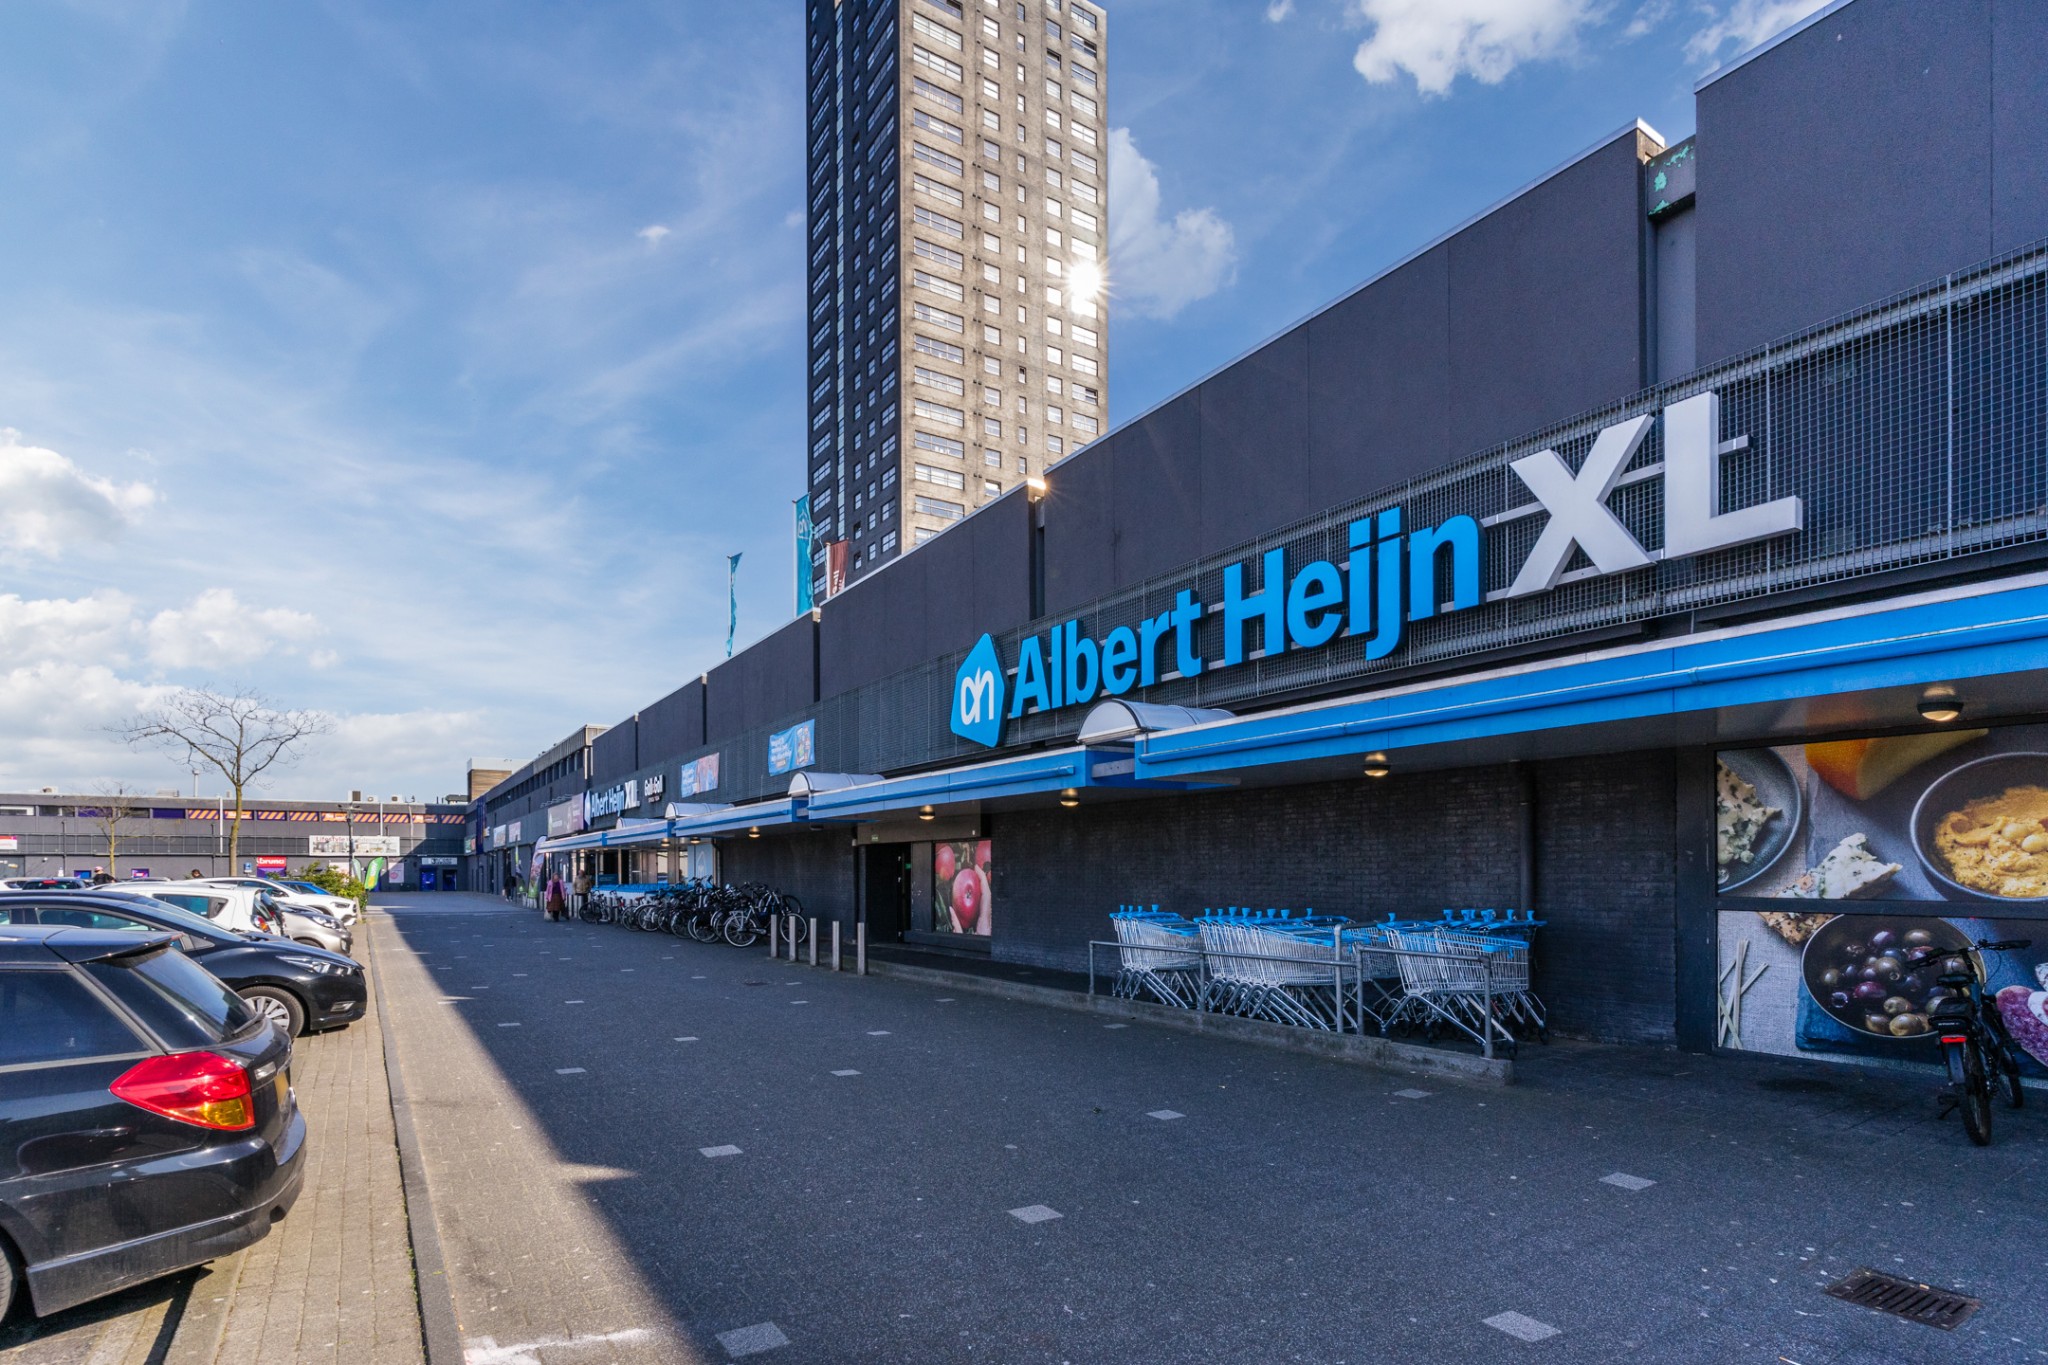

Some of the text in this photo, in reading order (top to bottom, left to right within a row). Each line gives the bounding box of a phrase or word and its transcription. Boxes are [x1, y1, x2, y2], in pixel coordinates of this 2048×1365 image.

[1011, 391, 1802, 718] Albert Heijn XL
[591, 792, 609, 818] Albert
[609, 785, 625, 817] Heijn
[624, 780, 640, 809] XL
[259, 857, 285, 865] bruna
